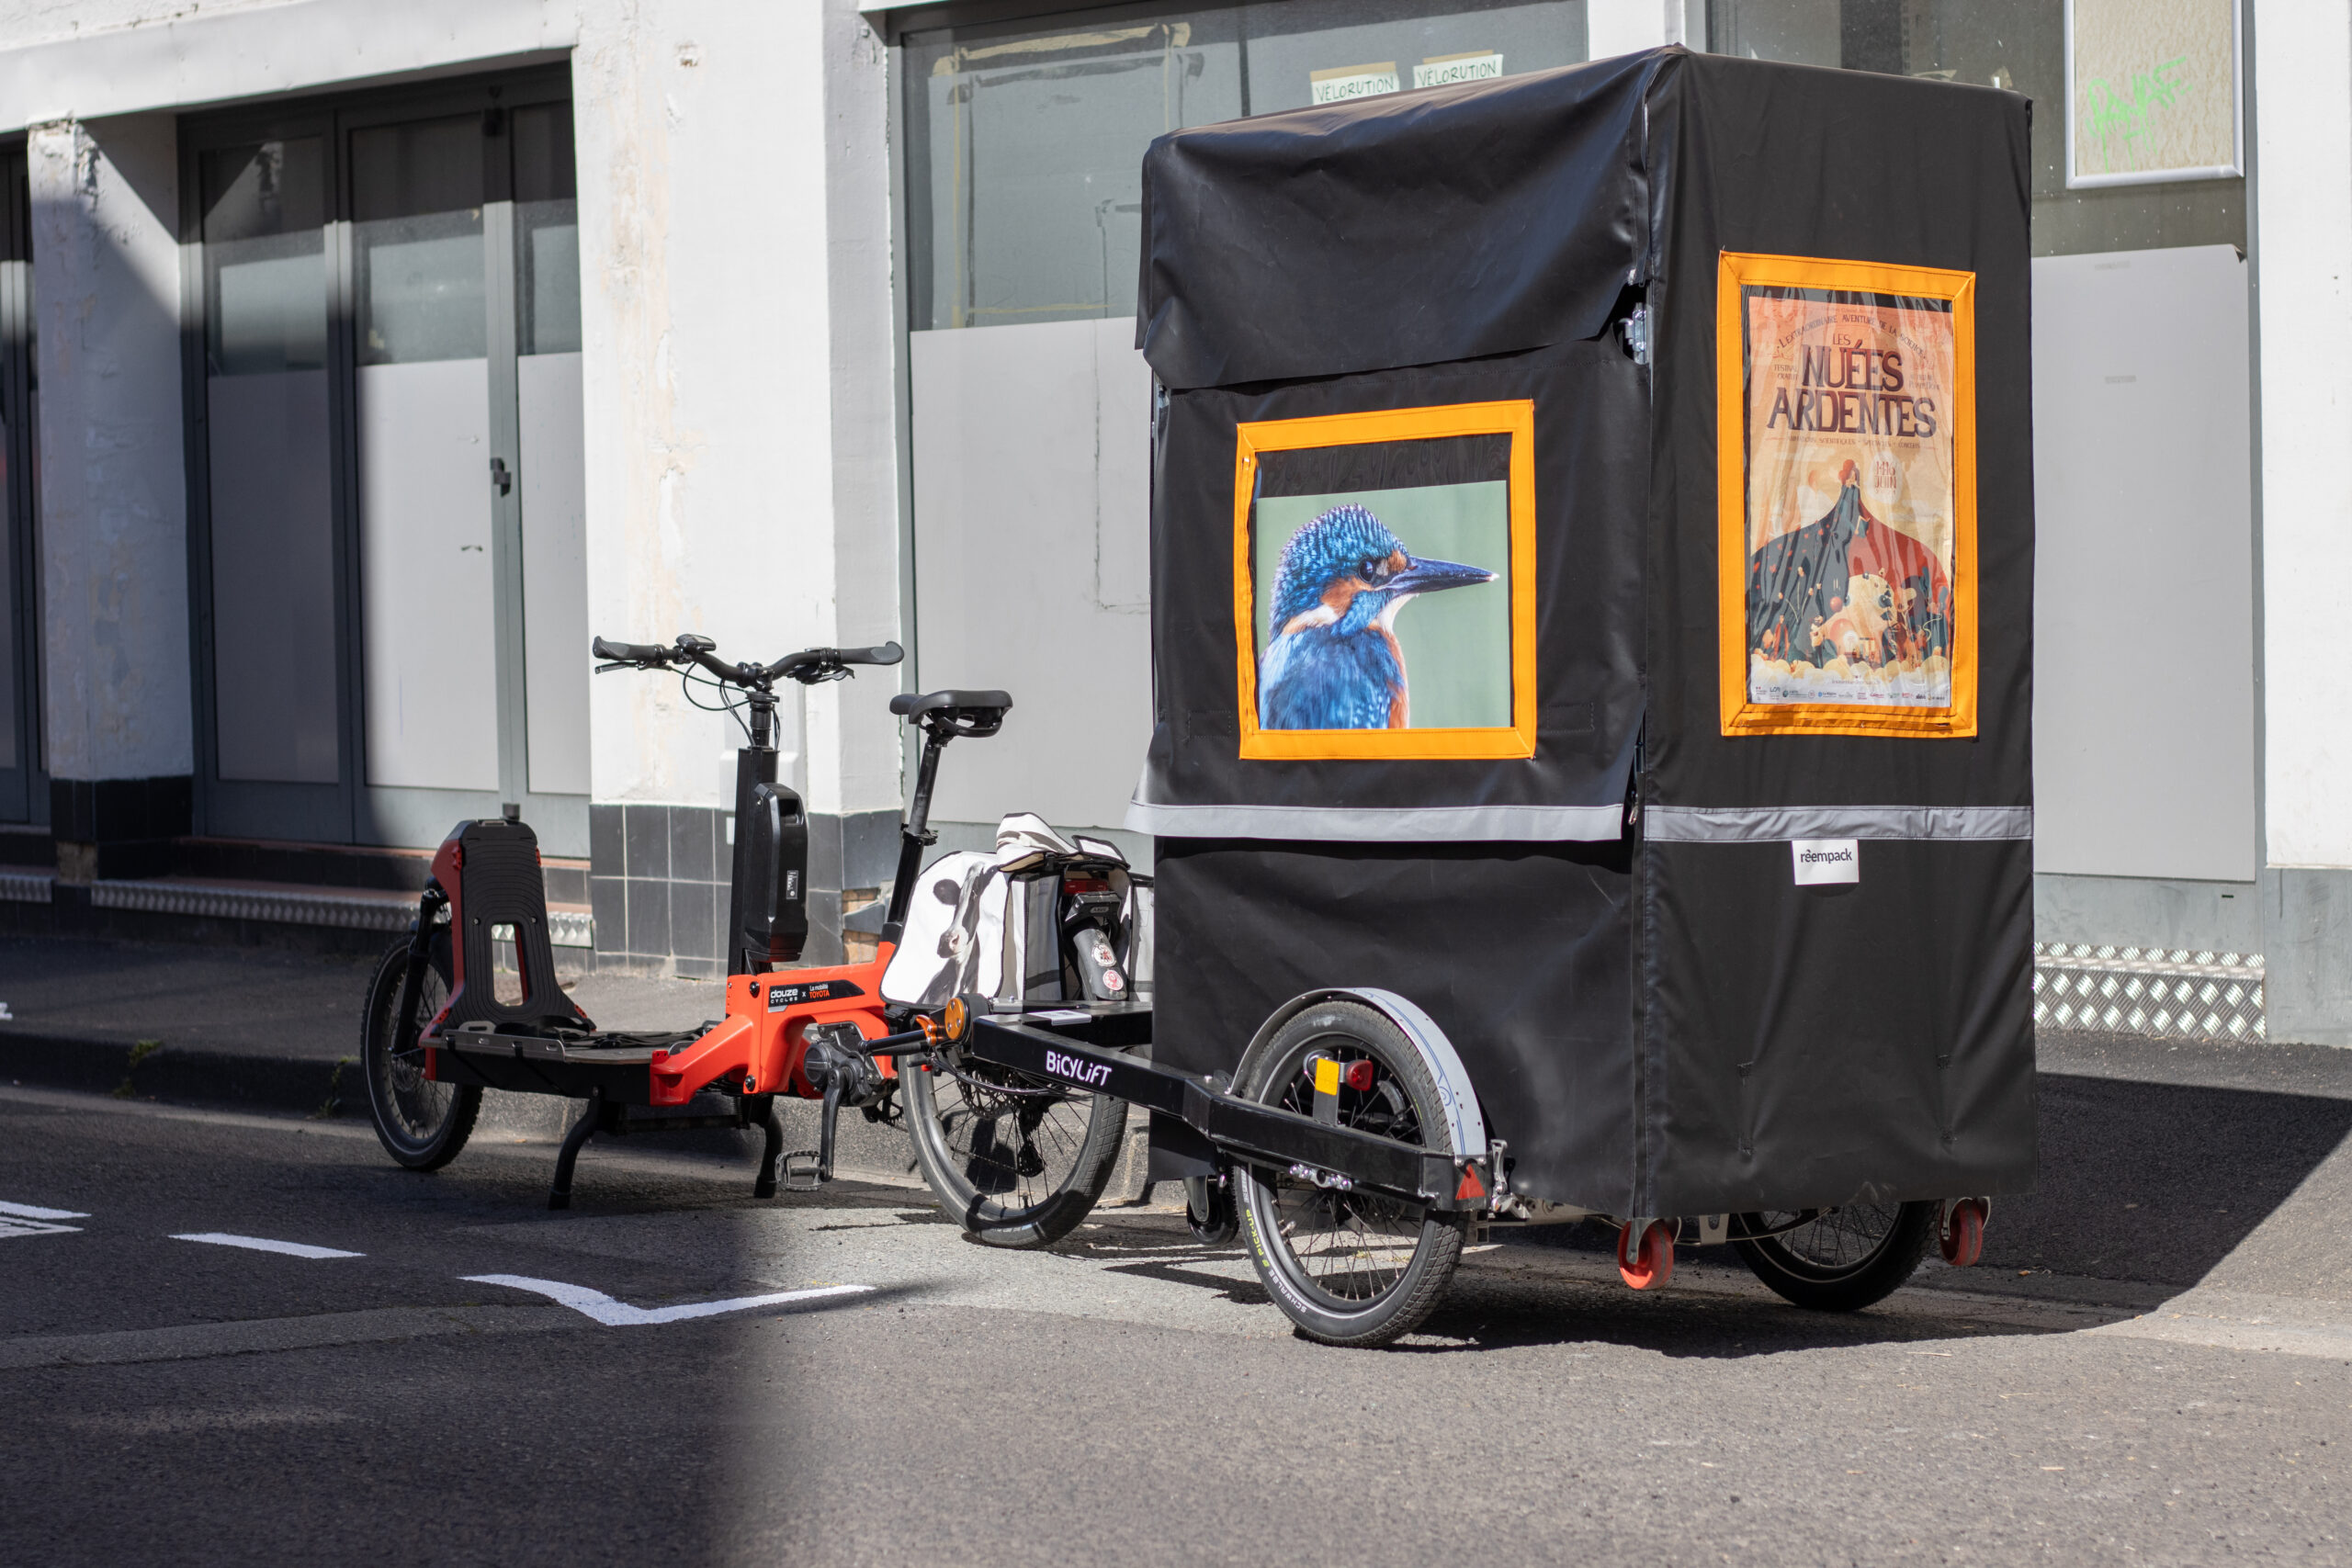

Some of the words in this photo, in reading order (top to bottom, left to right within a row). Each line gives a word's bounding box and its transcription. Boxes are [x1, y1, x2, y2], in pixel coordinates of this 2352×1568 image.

[1418, 60, 1497, 86] VÉLORUTION
[1316, 75, 1395, 102] VÉLORUTION
[1832, 333, 1851, 345] LES
[1802, 339, 1904, 392] NUÉES
[1767, 387, 1937, 438] ARDENTES
[770, 988, 798, 998] douze
[770, 996, 798, 1004] CYCLES
[809, 989, 830, 999] TOYOTA
[1246, 1209, 1264, 1257] PICK-UP
[1268, 1269, 1306, 1314] SCHWALBE
